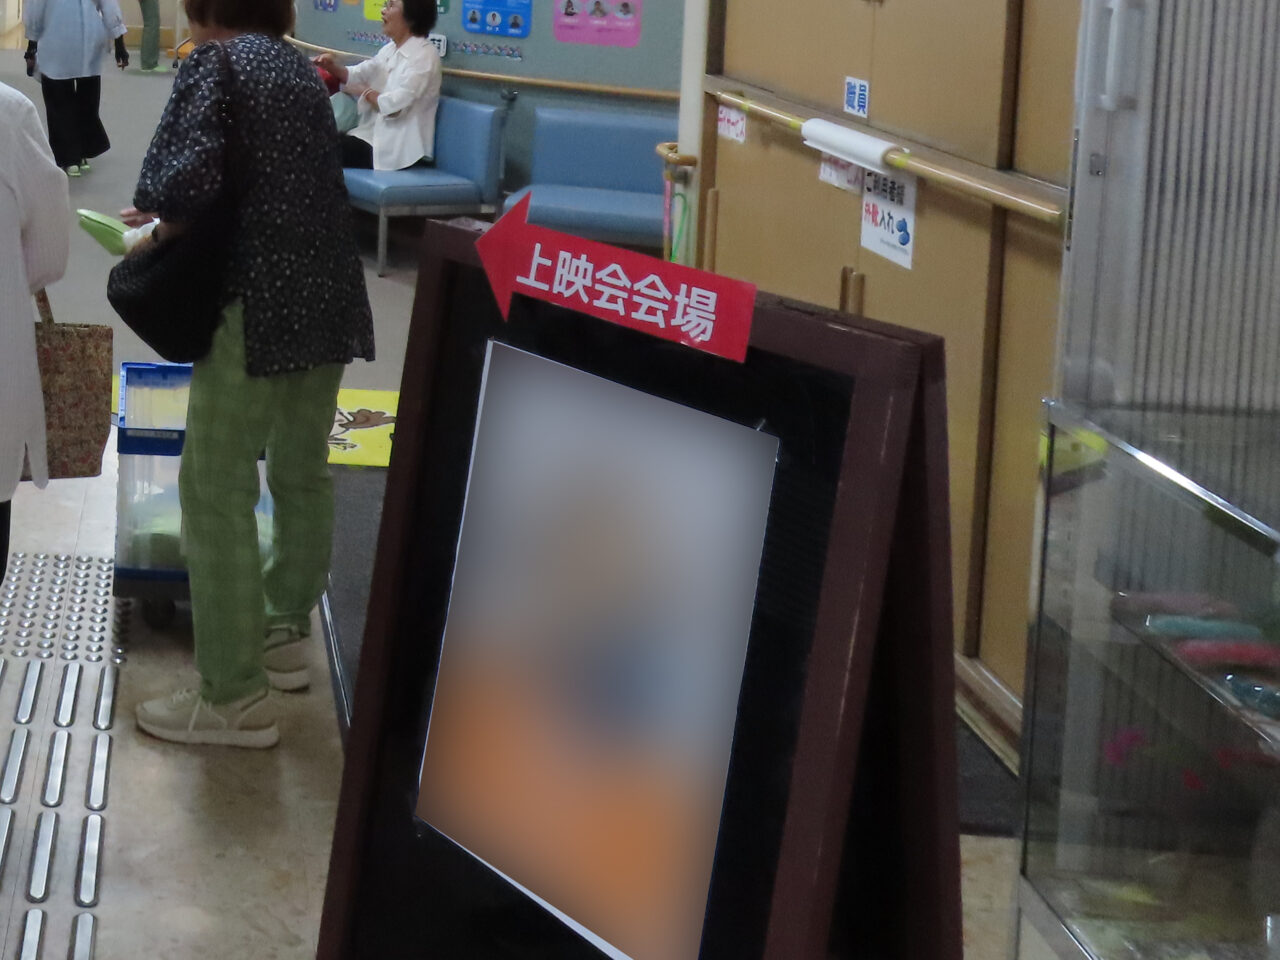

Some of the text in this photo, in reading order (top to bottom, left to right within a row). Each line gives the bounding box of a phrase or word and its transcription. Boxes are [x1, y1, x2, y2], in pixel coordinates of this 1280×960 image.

[515, 242, 718, 342] 上映会会場
